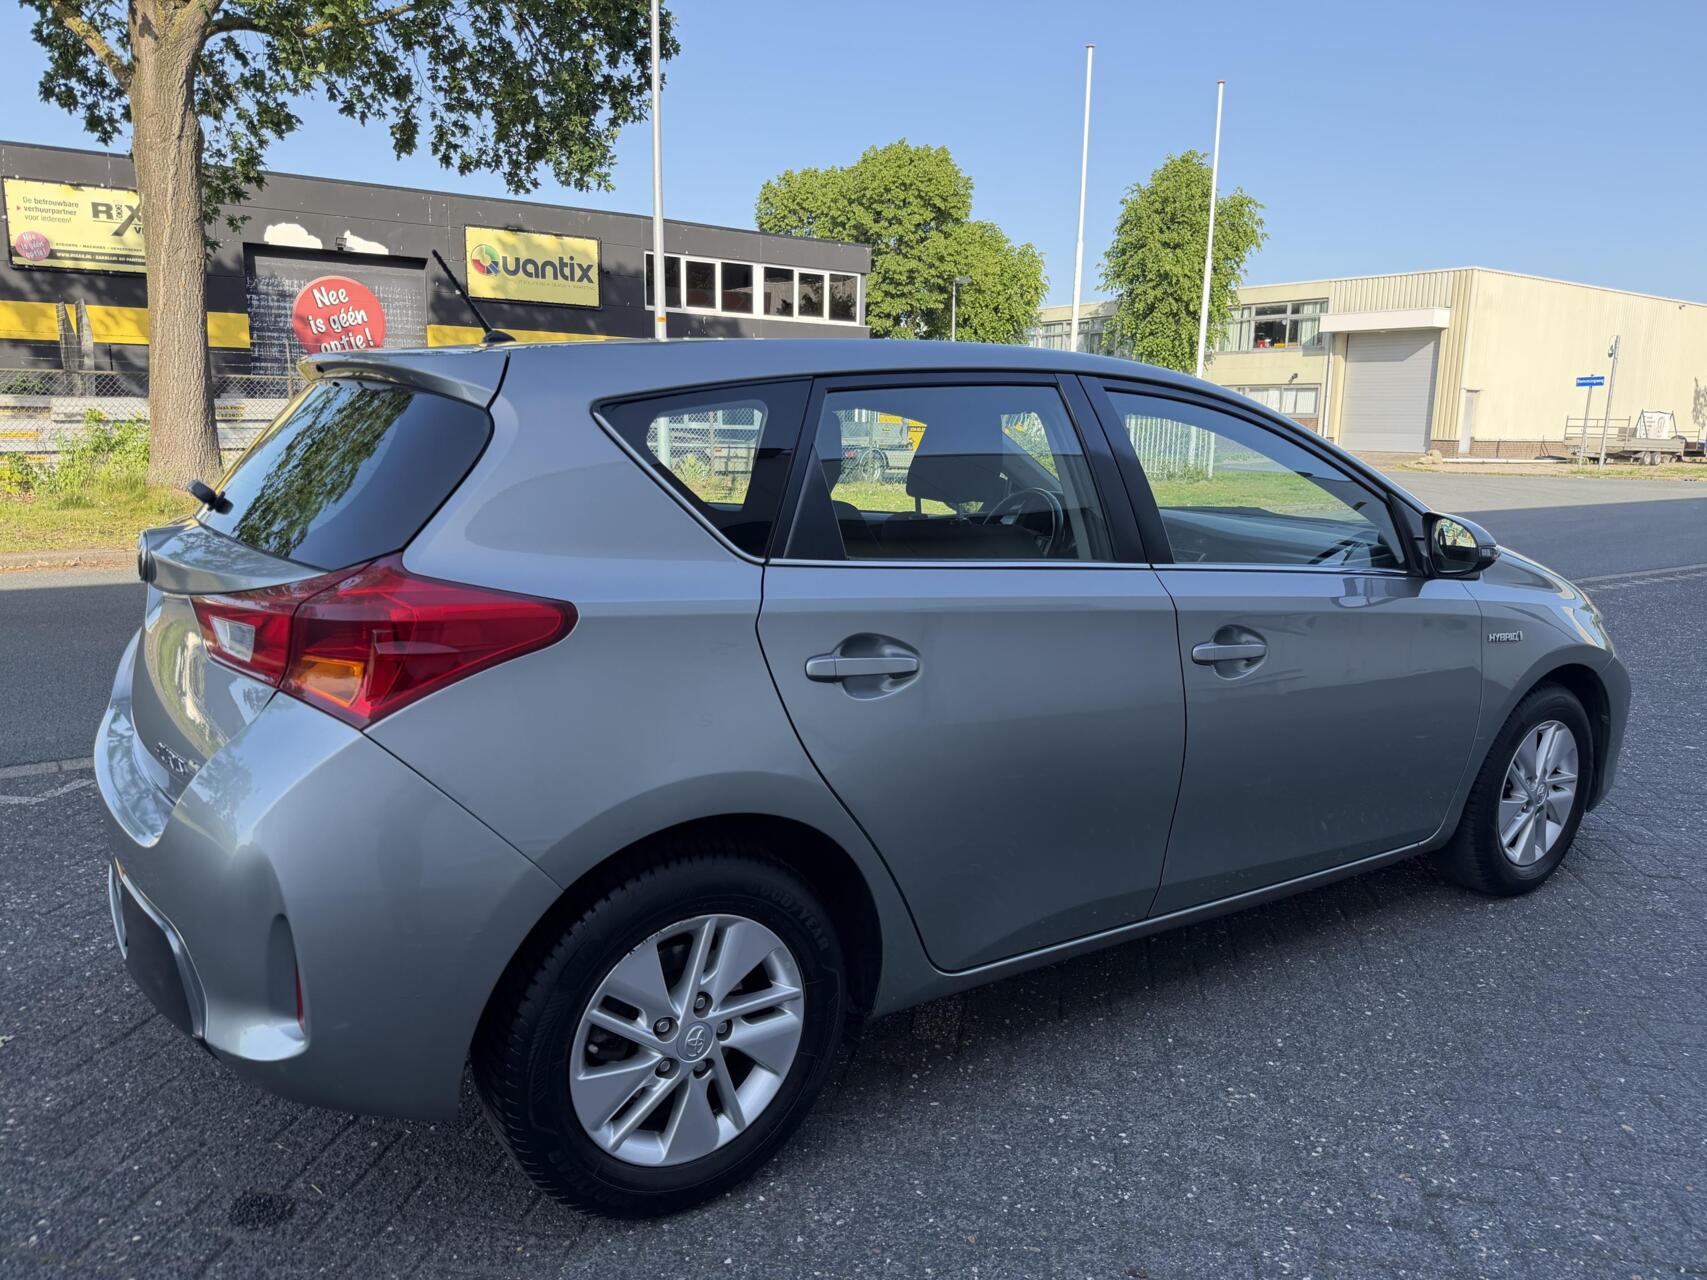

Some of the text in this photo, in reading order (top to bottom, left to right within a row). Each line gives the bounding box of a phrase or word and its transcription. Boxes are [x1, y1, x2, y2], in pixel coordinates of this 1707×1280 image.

[33, 197, 80, 209] betrouwbare
[23, 205, 77, 217] verhuurpartner
[312, 286, 349, 308] Nee
[307, 306, 368, 334] is géén
[1488, 632, 1518, 642] HYBRID
